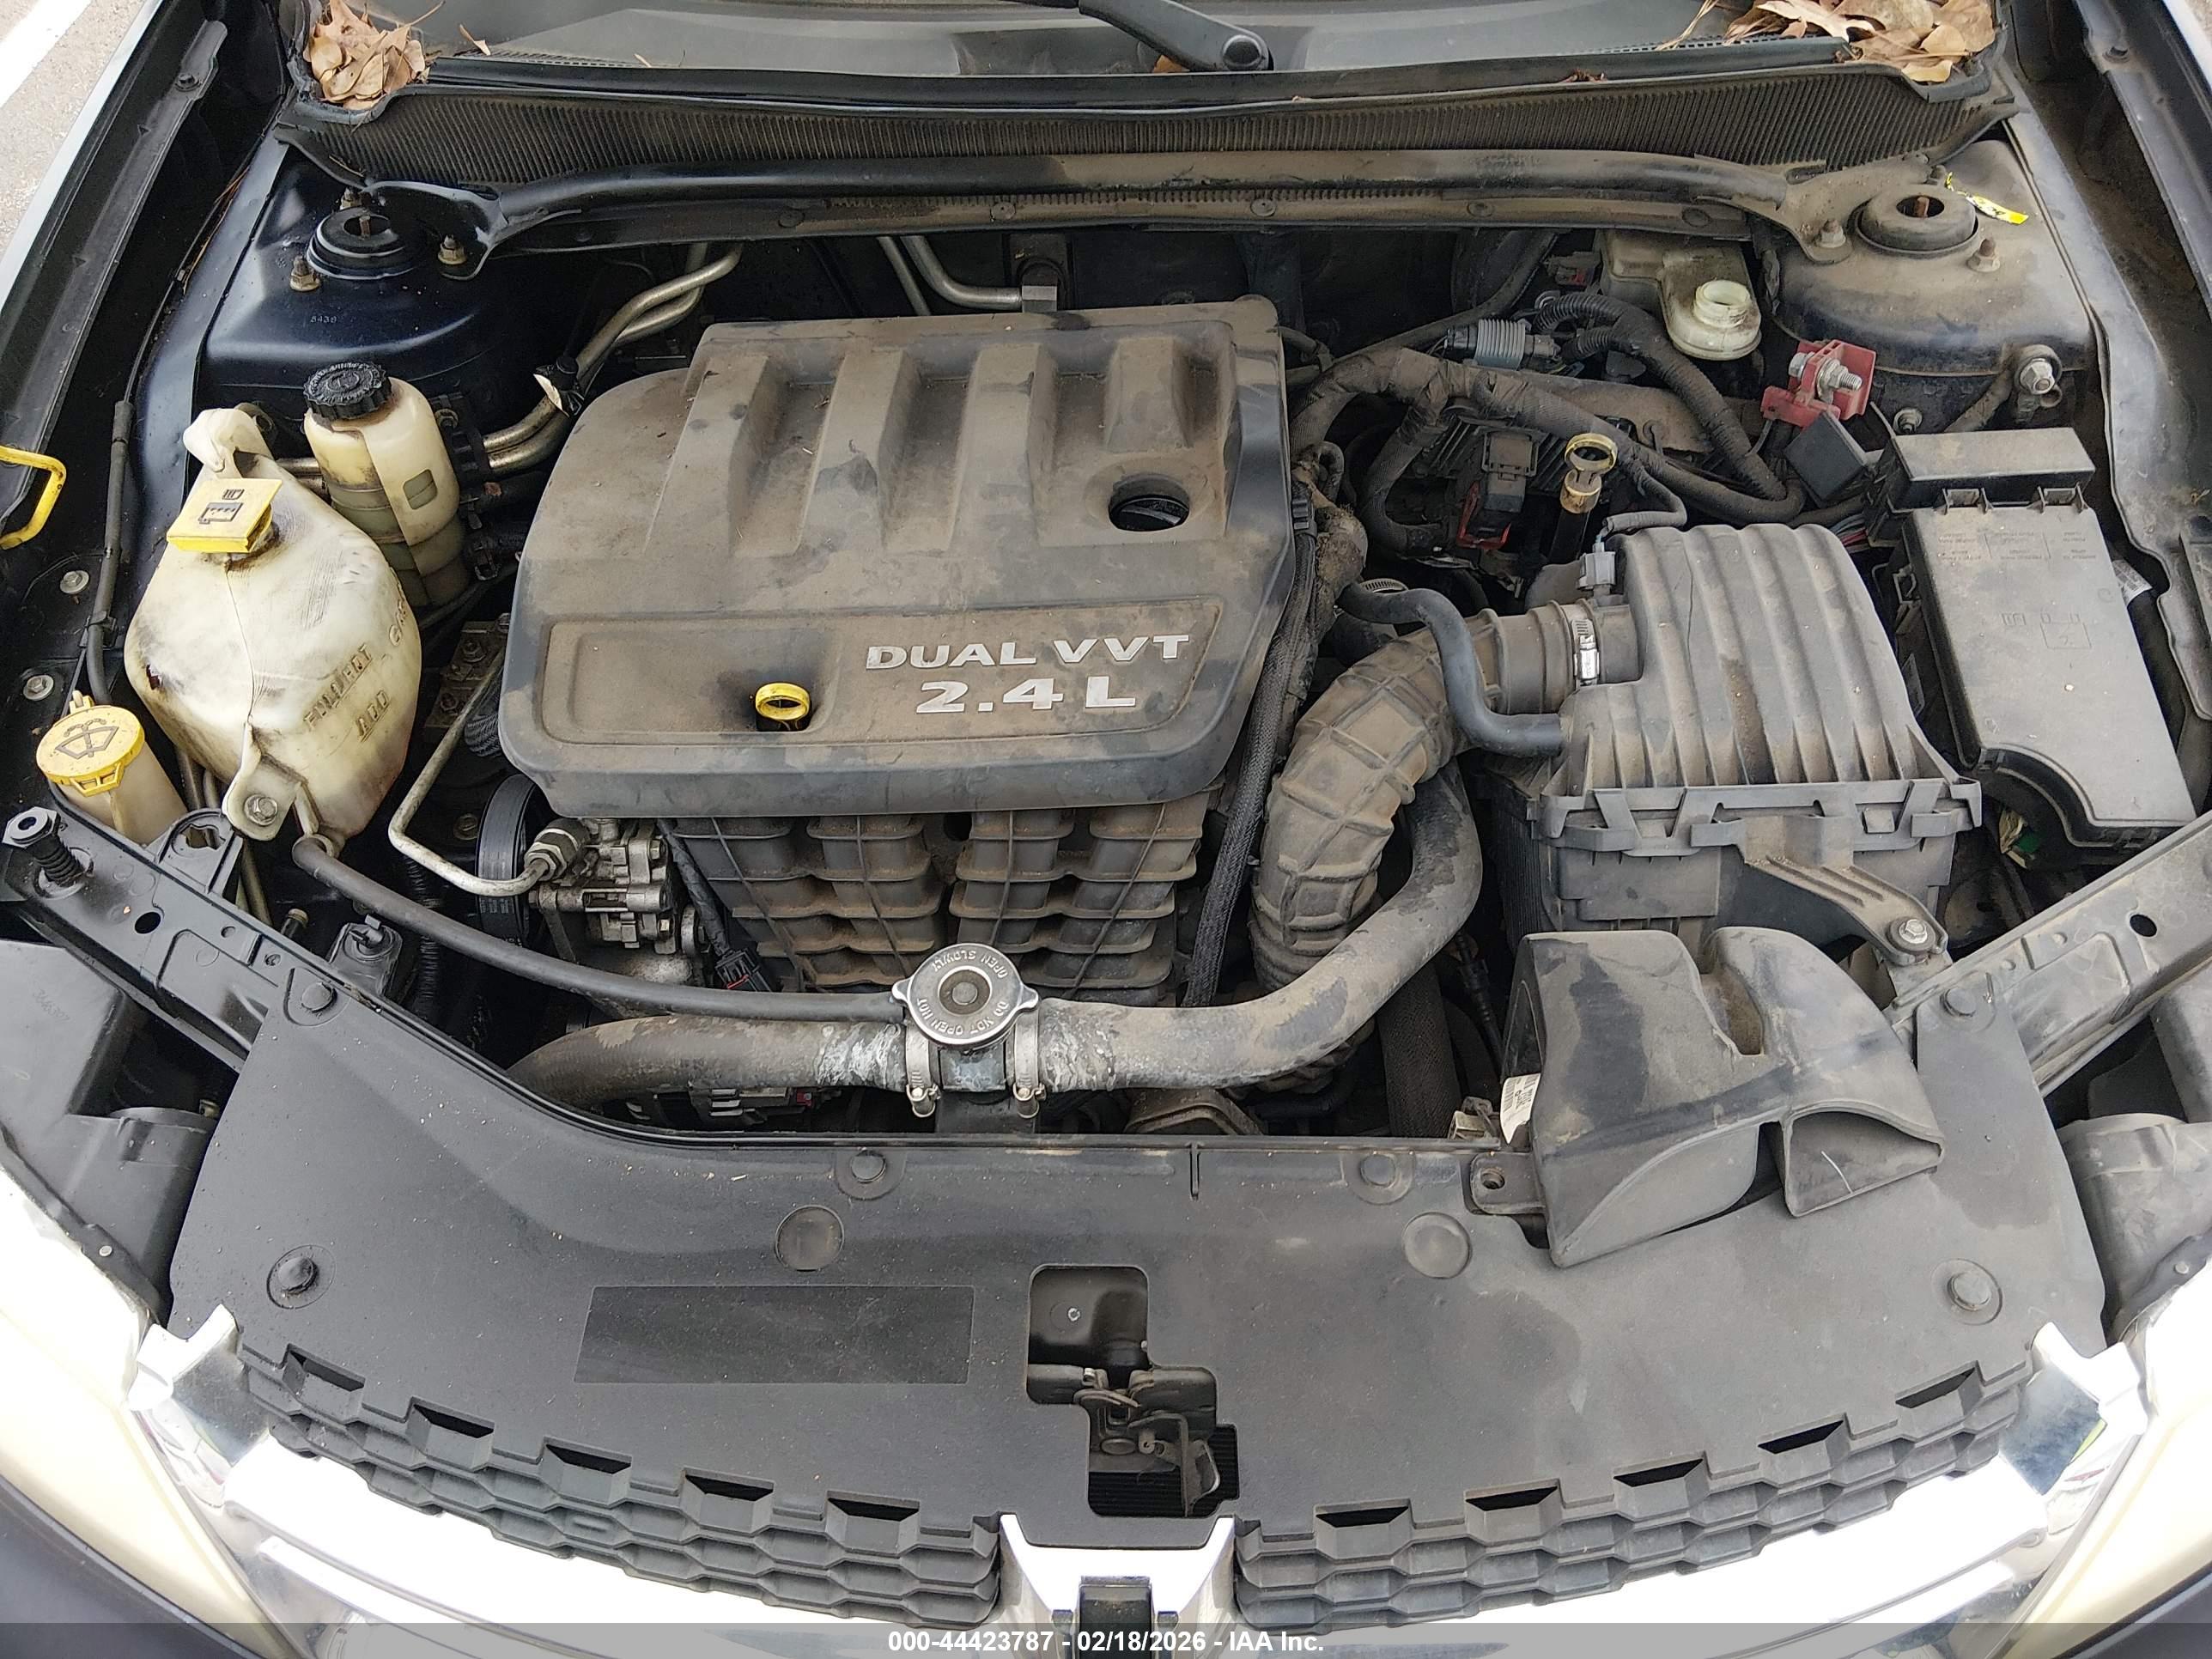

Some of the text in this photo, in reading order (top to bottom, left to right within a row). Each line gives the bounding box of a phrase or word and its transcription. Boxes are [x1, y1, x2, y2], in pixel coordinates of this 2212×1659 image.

[866, 635, 1189, 670] DUAL VVT
[355, 690, 390, 738] ADD
[916, 676, 1136, 714] 2.4 L
[932, 950, 1008, 979] OPEN SLOWLY
[917, 998, 1010, 1036] DO NOT OPEN HOT
